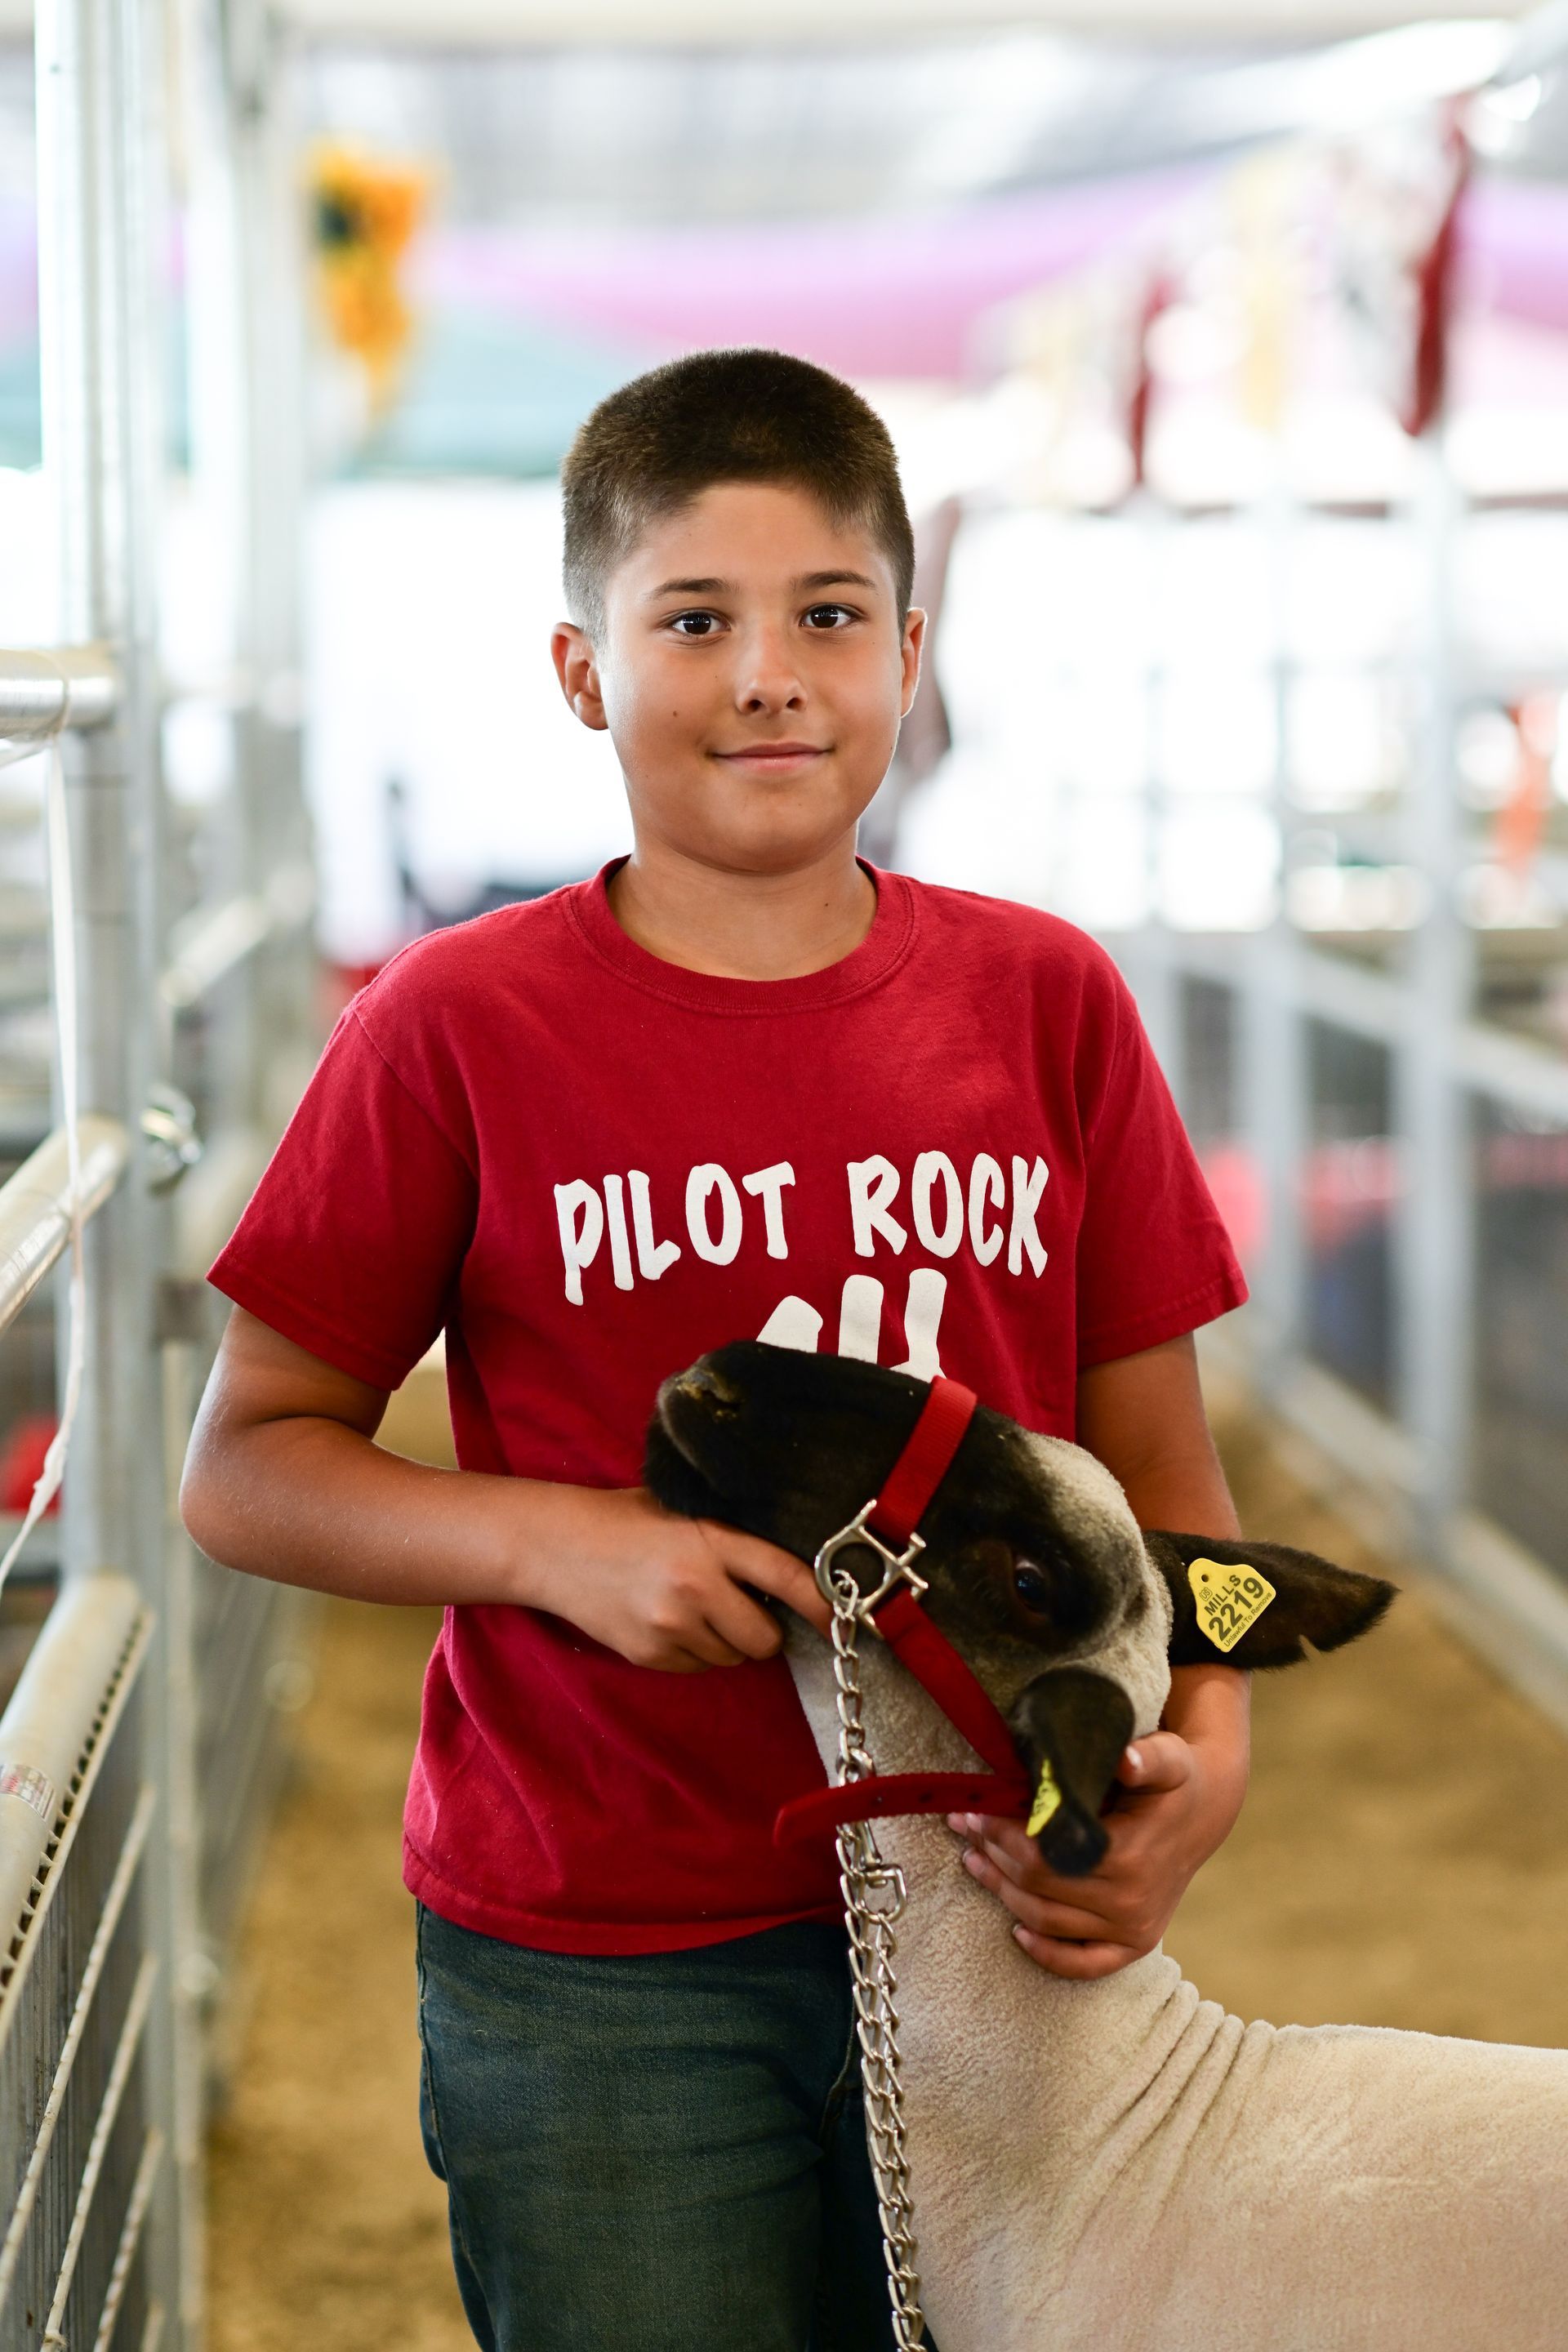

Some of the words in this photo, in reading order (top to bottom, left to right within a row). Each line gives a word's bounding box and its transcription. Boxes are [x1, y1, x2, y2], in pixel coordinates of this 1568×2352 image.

[554, 1161, 795, 1306] PILOT
[846, 1150, 1049, 1278] ROCK
[1200, 1588, 1211, 1600] US
[1204, 1575, 1241, 1616] MILLS
[1209, 1577, 1264, 1642] 2219
[1223, 1622, 1246, 1647] Unlawful
[1244, 1615, 1253, 1624] To
[1251, 1592, 1272, 1616] Remove
